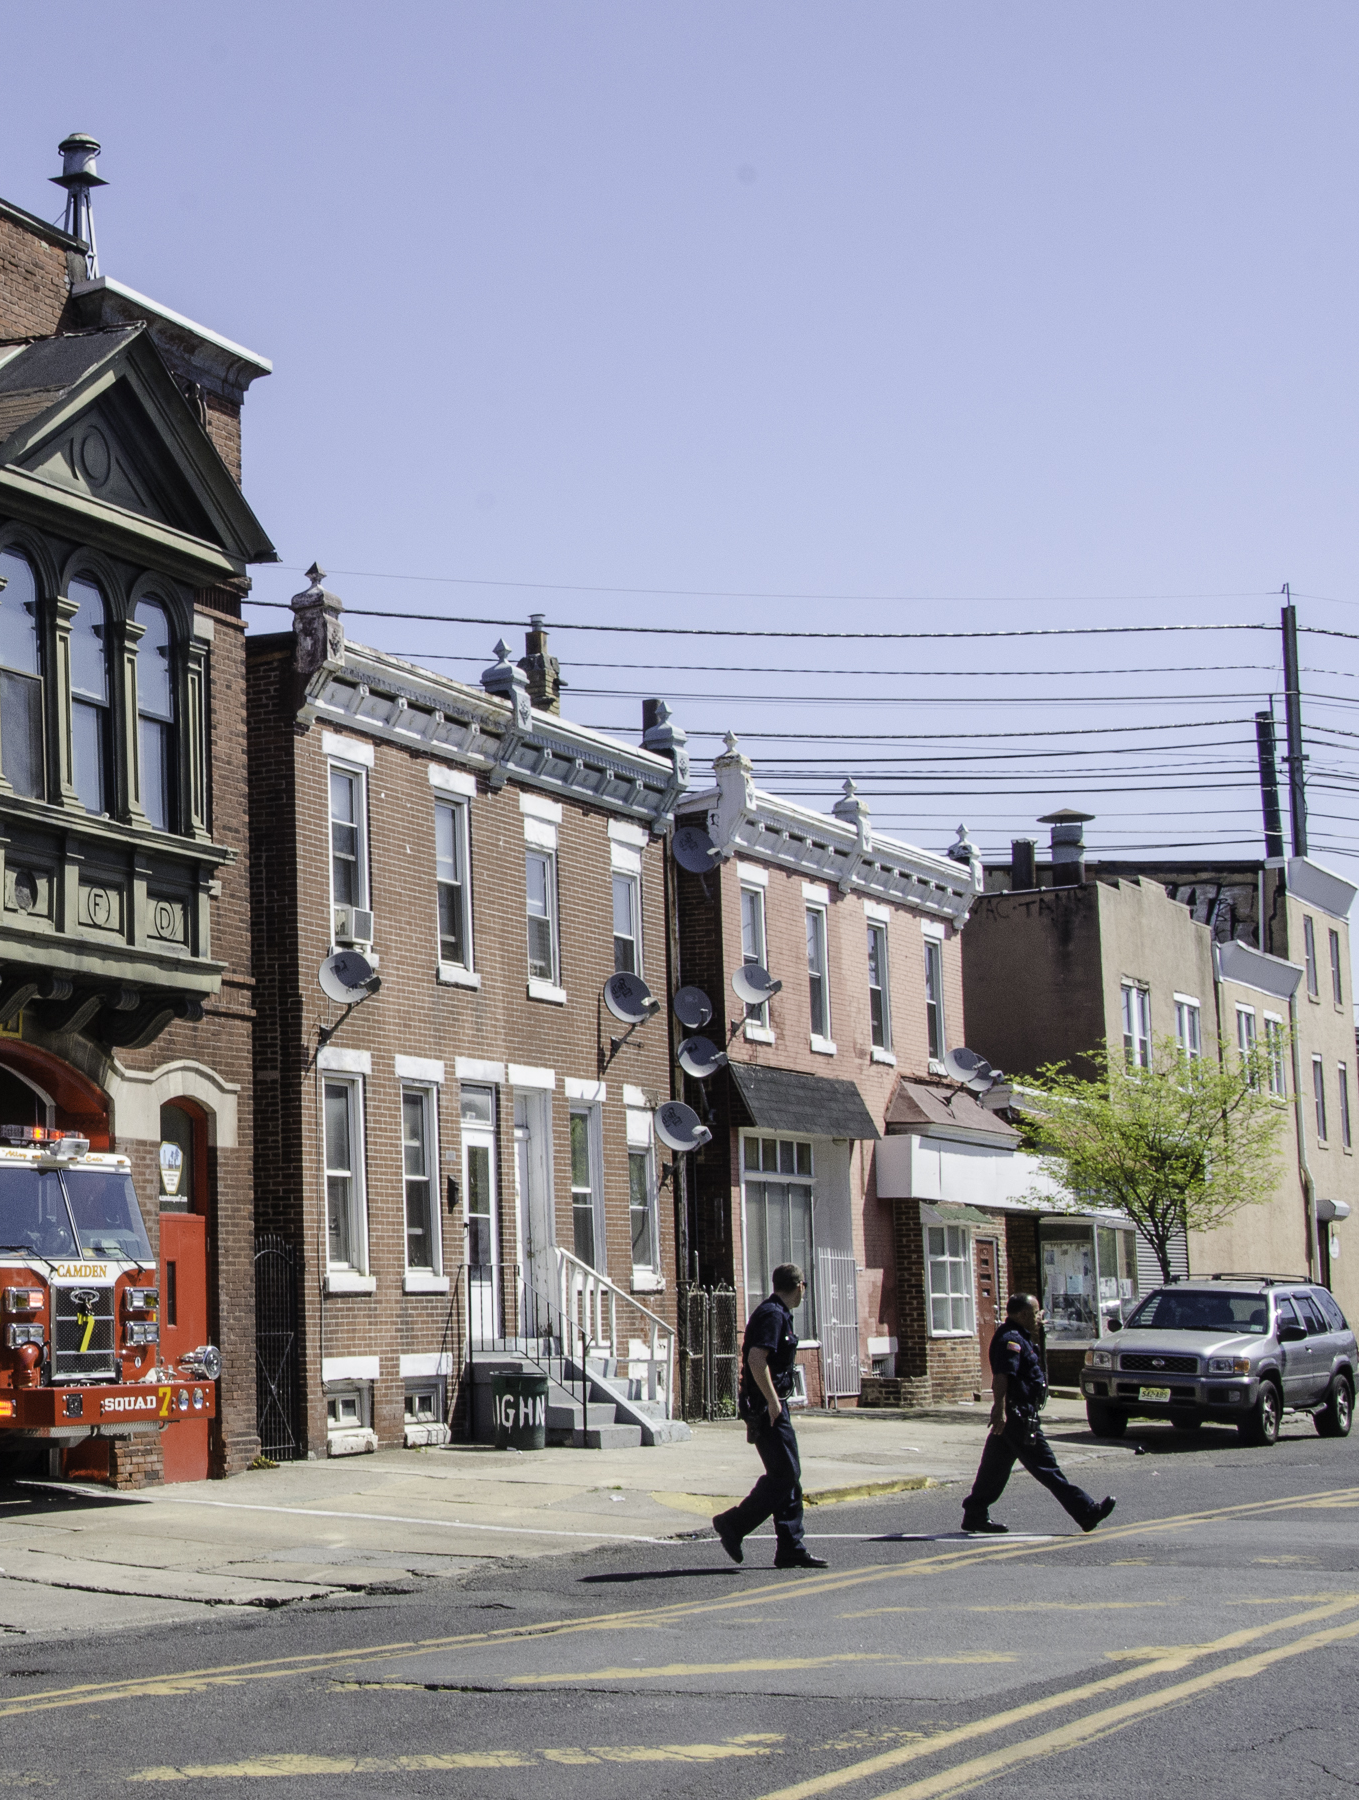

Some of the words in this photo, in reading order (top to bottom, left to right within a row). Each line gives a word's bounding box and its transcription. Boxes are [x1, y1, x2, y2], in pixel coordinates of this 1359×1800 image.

[93, 893, 104, 917] F
[159, 907, 171, 930] D
[57, 1264, 107, 1278] CAMDEN
[77, 1312, 95, 1353] 7
[104, 1396, 157, 1412] SQUAD
[158, 1387, 172, 1417] 7
